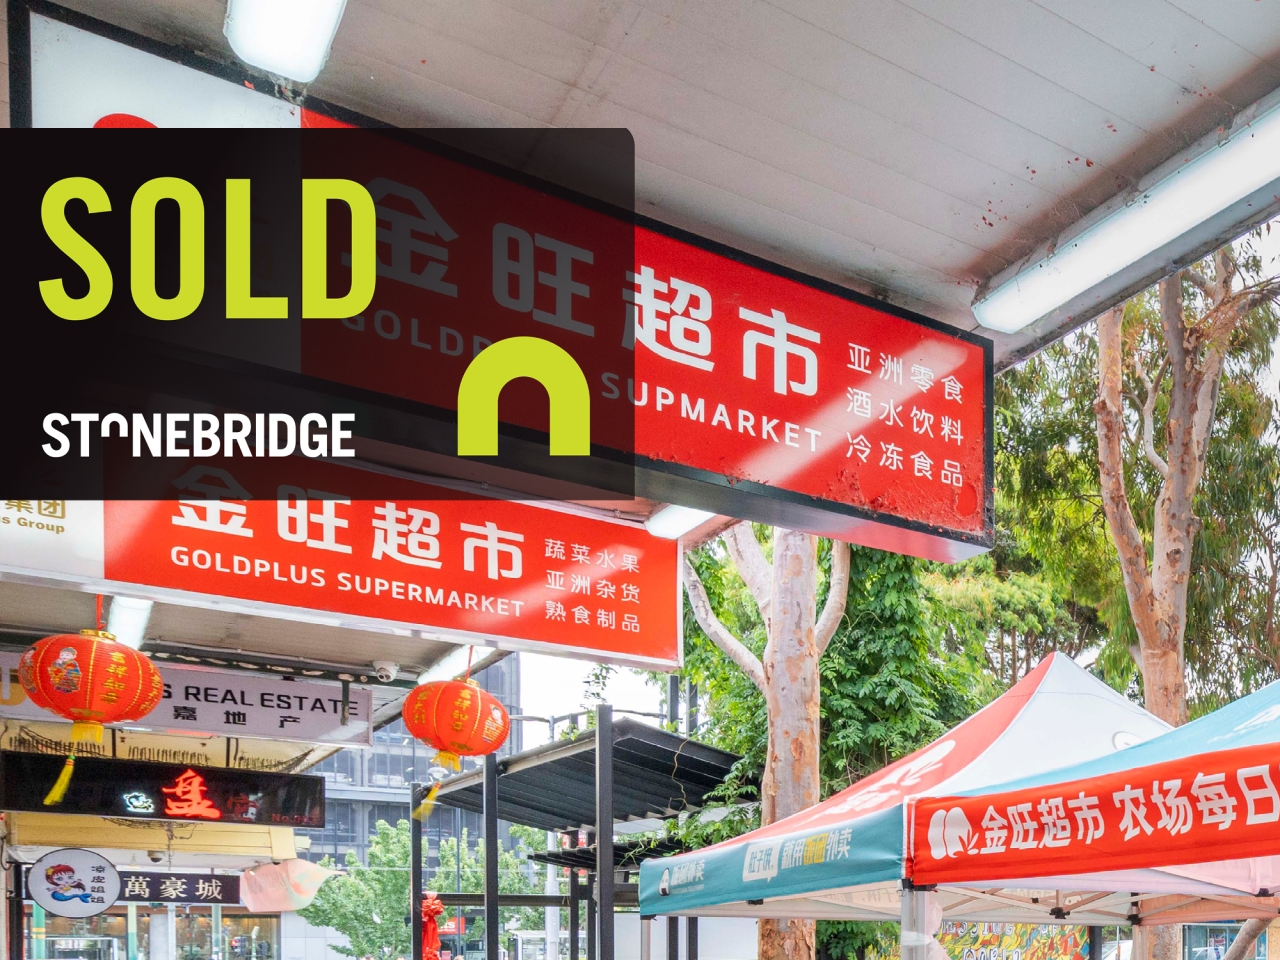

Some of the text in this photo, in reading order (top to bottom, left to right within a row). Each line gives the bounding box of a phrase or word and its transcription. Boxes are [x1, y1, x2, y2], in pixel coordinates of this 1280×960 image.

[847, 343, 964, 404] 亚洲零食
[602, 372, 821, 451] SUPMARKET
[846, 387, 964, 446] 酒水饮料
[846, 432, 964, 487] 冷冻食品
[17, 517, 65, 534] Group
[171, 465, 524, 580] 金旺超市
[170, 546, 524, 617] GOLDPLUS SUPERMARKET
[544, 538, 640, 573] 蔬菜水果
[544, 569, 640, 604] 亚洲杂货
[544, 600, 640, 632] 熟食制品
[184, 685, 254, 706] REAL
[260, 692, 358, 716] ESTATE
[980, 792, 1104, 855] 金旺超市
[124, 876, 222, 901] 萬豪城
